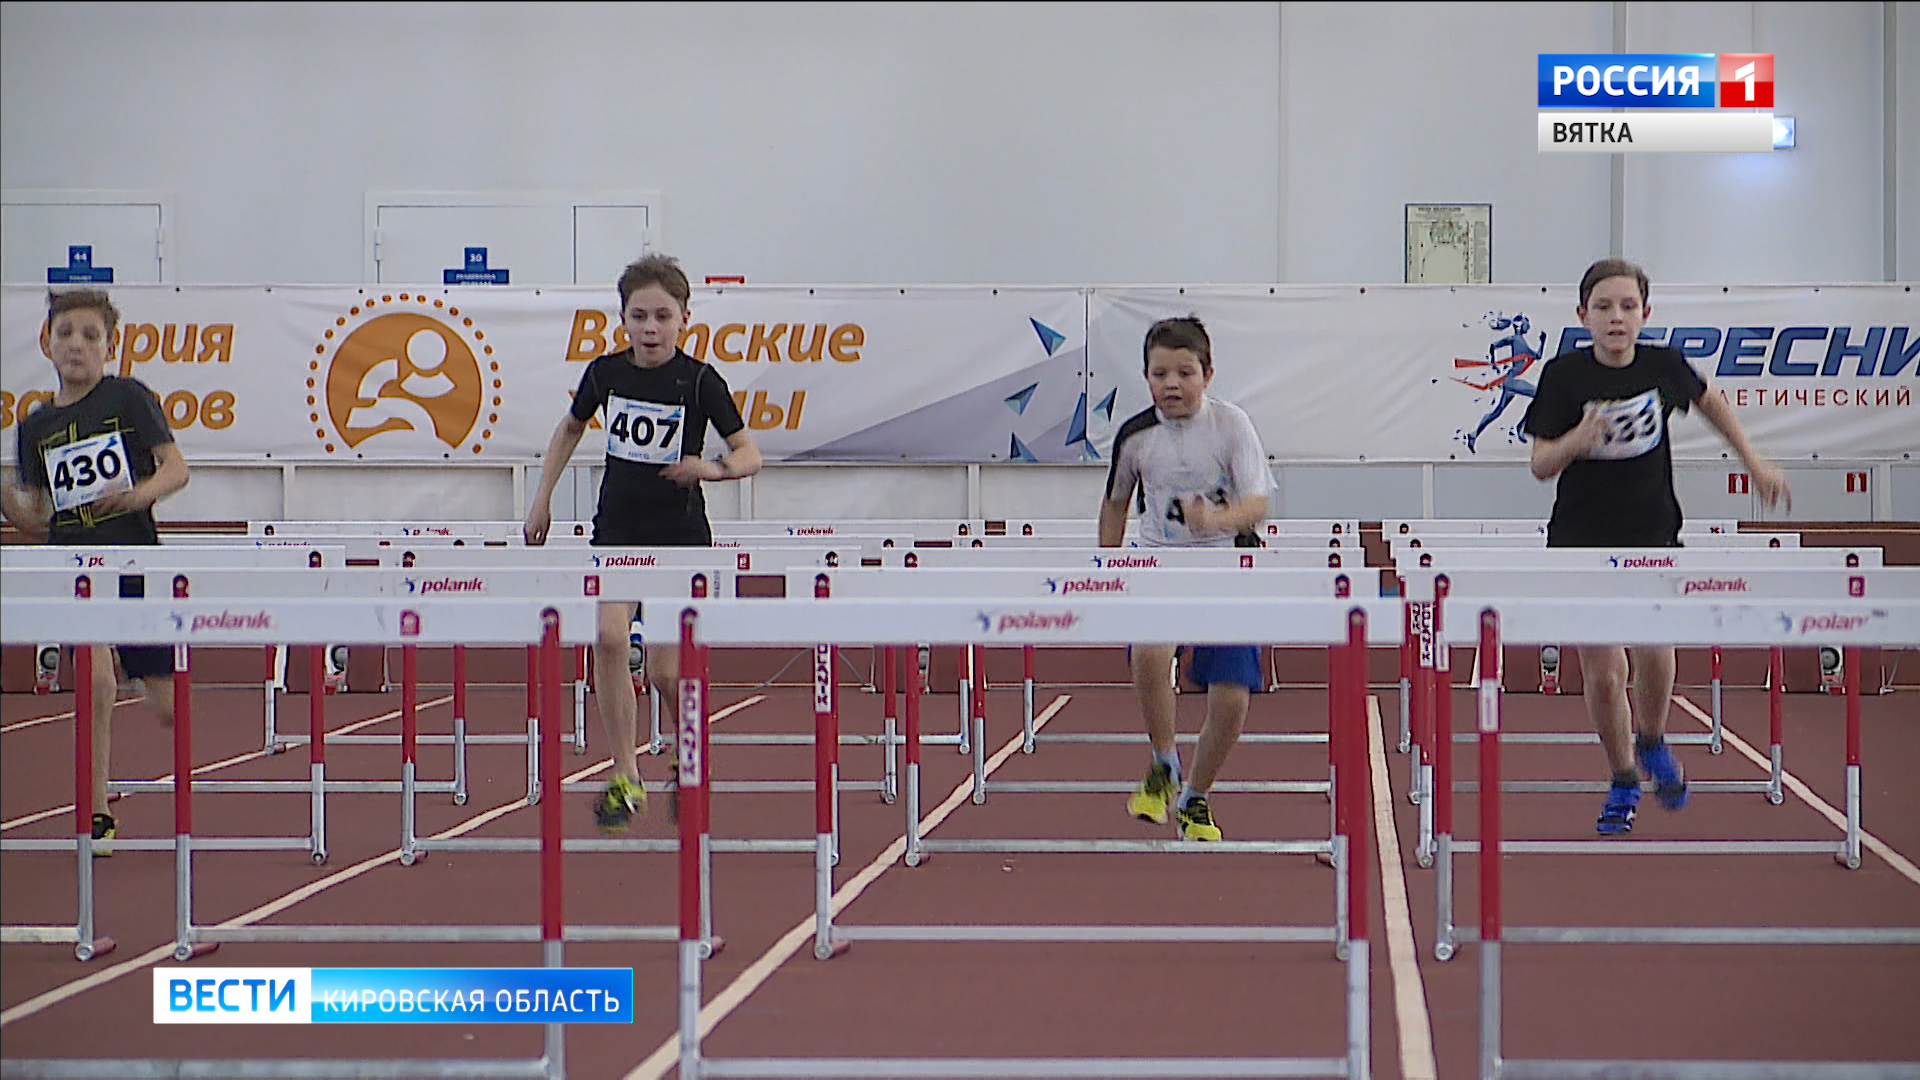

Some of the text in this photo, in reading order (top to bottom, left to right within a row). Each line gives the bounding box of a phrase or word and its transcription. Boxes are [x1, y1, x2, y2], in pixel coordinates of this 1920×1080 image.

[40, 317, 234, 377] рия
[1557, 327, 1920, 377] РЕСНИ
[610, 411, 680, 449] 407
[1604, 410, 1657, 445] 33
[54, 449, 121, 492] 430
[606, 555, 656, 568] polanik
[1107, 555, 1158, 568] polanik
[1623, 555, 1674, 568] polanik
[421, 577, 483, 595] polanik
[1062, 577, 1125, 596] polanik
[1684, 577, 1747, 595] polanik
[190, 608, 272, 633] polanik
[817, 643, 829, 706] OLANIK
